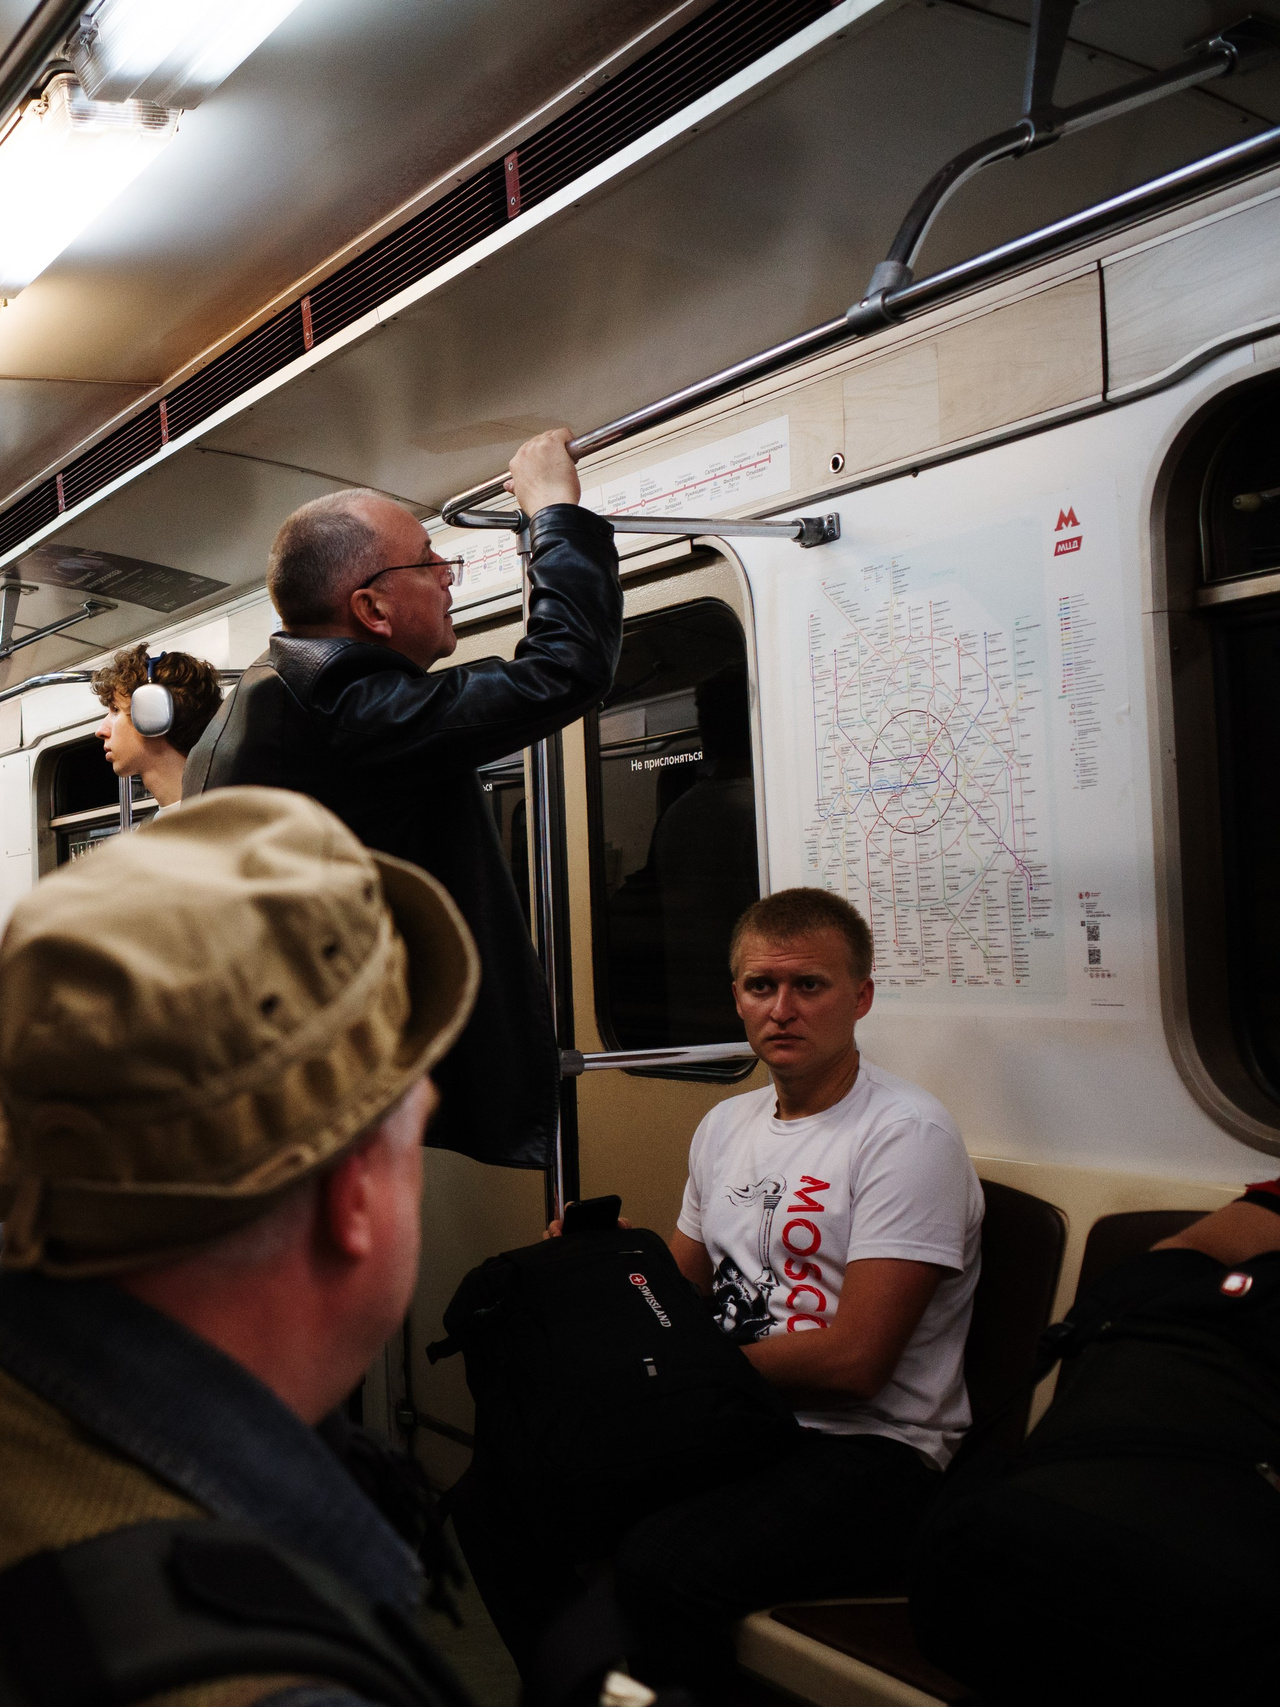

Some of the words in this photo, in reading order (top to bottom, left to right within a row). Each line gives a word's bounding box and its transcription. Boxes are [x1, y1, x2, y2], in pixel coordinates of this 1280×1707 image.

[1056, 539, 1079, 553] МЦД
[631, 760, 643, 771] Не
[644, 751, 703, 771] прислоняться
[637, 1285, 672, 1328] SWISSLAND
